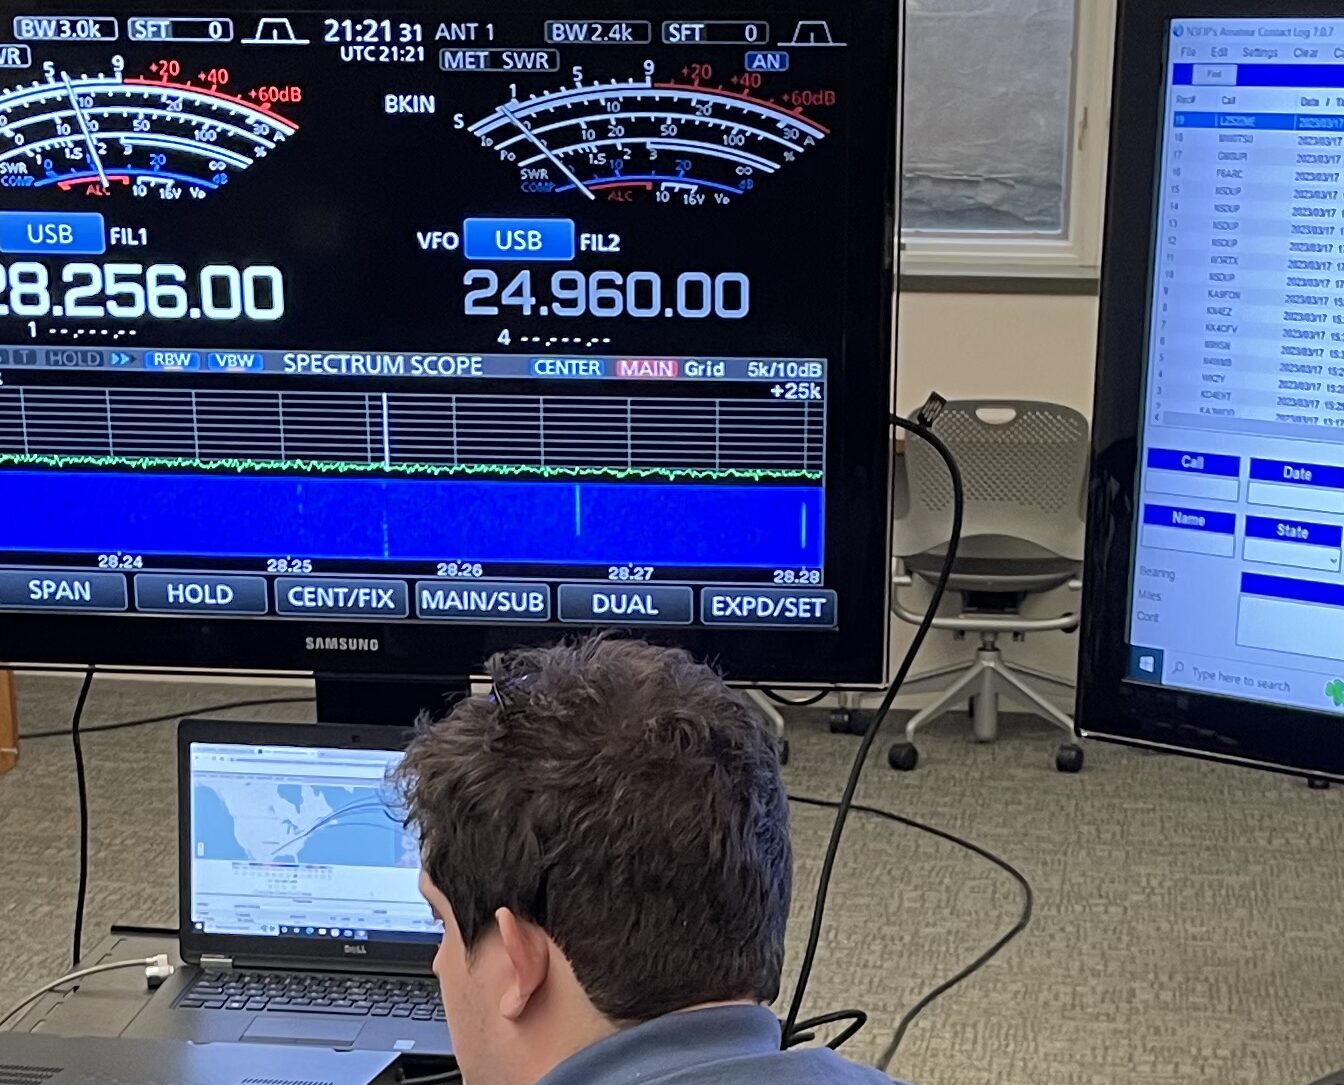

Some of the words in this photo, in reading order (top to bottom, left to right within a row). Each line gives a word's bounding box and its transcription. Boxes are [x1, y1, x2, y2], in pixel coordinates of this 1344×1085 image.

[21, 22, 56, 38] BW
[60, 21, 101, 39] 3.0k
[135, 22, 169, 39] SFT
[209, 22, 223, 39] 0
[324, 20, 392, 42] 21:21
[400, 24, 423, 41] 31
[435, 24, 478, 41] ANT
[486, 24, 495, 41] 1
[552, 24, 589, 41] BW
[591, 24, 632, 42] 2.4k
[669, 24, 705, 42] SFT
[744, 24, 757, 41] 0
[340, 46, 375, 62] UTC
[378, 46, 425, 62] 21:21
[443, 51, 489, 70] MET
[502, 51, 550, 70] SWR
[752, 52, 781, 68] AN
[1181, 47, 1196, 58] File
[149, 60, 180, 76] +20
[198, 69, 228, 84] +40
[248, 87, 302, 102] +60dB
[384, 95, 435, 114] BKIN
[27, 224, 73, 244] USB
[111, 227, 147, 245] FIL1
[417, 232, 459, 250] VFO
[496, 230, 542, 251] USB
[580, 233, 620, 252] FIL2
[463, 269, 749, 318] 24.960.00
[154, 352, 190, 367] RBW
[215, 353, 253, 368] VBW
[284, 354, 406, 374] SPECTRUM
[411, 356, 482, 375] SCOPE
[534, 360, 601, 376] CENTER
[621, 360, 673, 377] MAIN
[685, 360, 725, 377] Grid
[748, 361, 822, 379] 5k/10dB
[771, 384, 822, 399] +25k
[1182, 456, 1203, 469] Call
[1284, 466, 1312, 481] Date
[1172, 512, 1206, 527] Name
[1277, 525, 1309, 540] State
[98, 554, 143, 569] 28.24
[267, 557, 312, 573] 28.25
[437, 562, 482, 577] 28.26
[608, 566, 654, 581] 28.27
[773, 568, 820, 585] 28.28
[29, 580, 91, 601] SPAN
[167, 584, 233, 605] HOLD
[288, 587, 395, 610] CENT/FIX
[422, 590, 545, 613] MAIN/SUB
[593, 593, 659, 614] DUAL
[712, 596, 826, 618] EXPD/SET
[305, 636, 379, 652] SAMSUNG
[1192, 667, 1216, 681] Type
[1218, 671, 1241, 684] here
[1244, 677, 1254, 687] to
[1257, 678, 1291, 692] search
